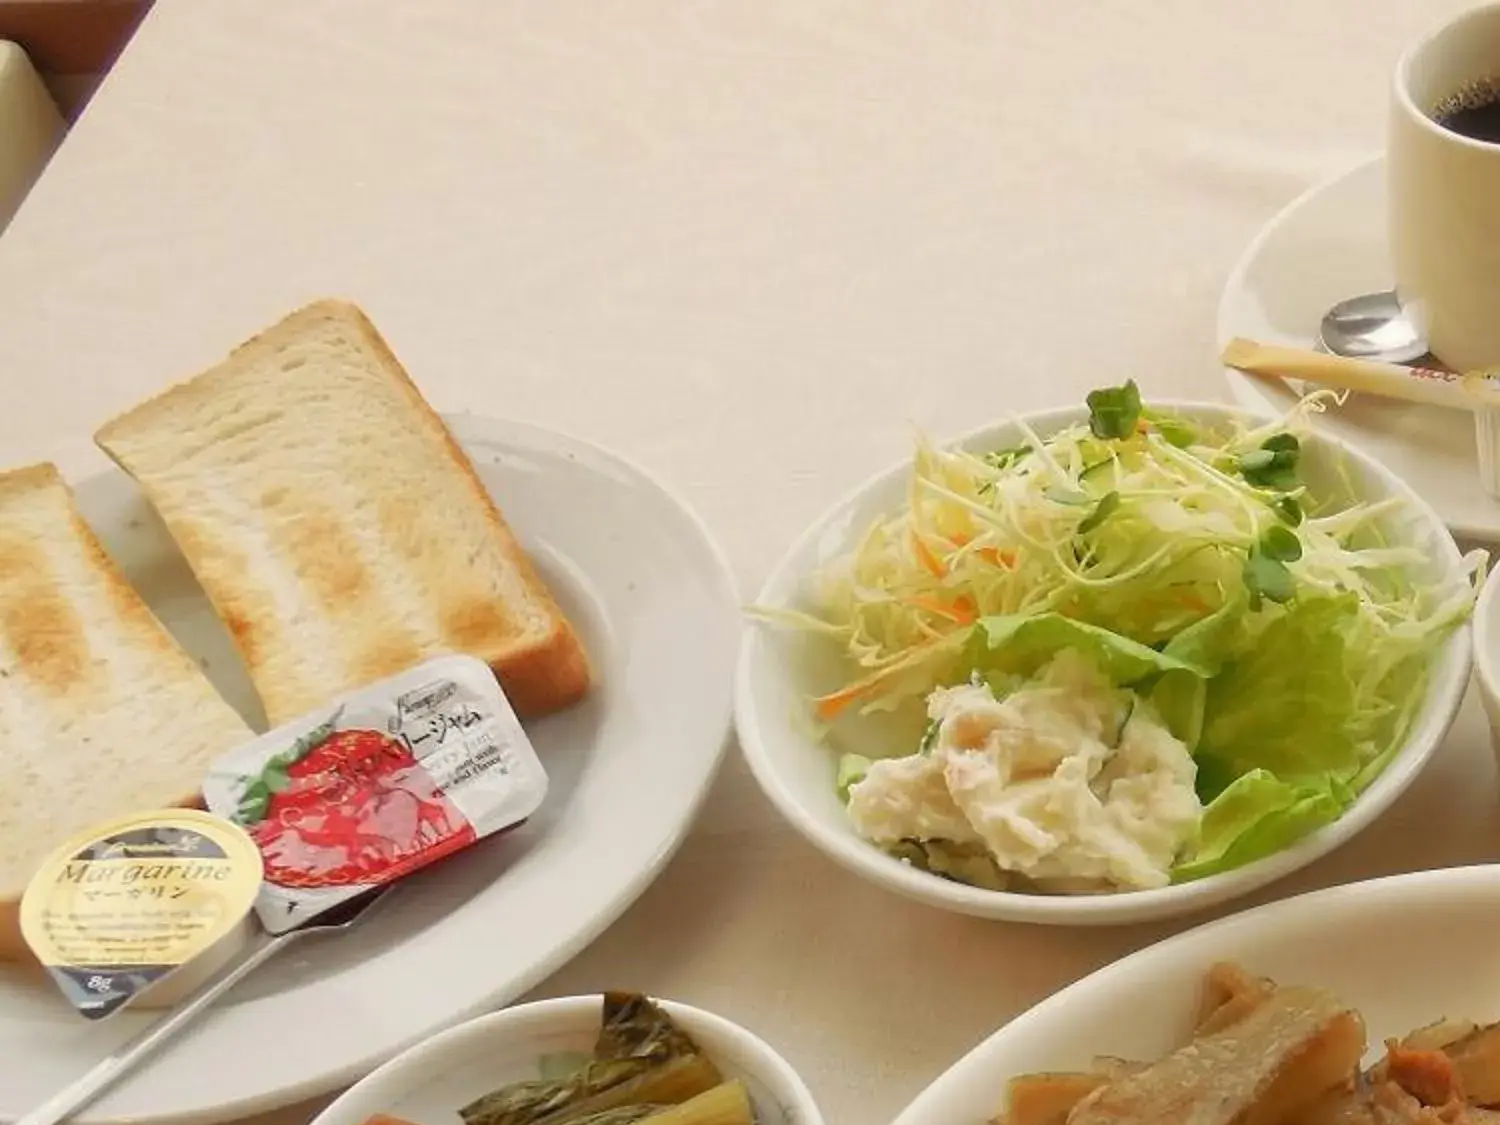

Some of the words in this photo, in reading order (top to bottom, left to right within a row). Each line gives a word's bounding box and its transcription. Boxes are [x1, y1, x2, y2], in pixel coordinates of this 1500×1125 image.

[56, 861, 232, 885] Margarine
[83, 884, 190, 901] マーガリン
[87, 975, 113, 993] 8g
